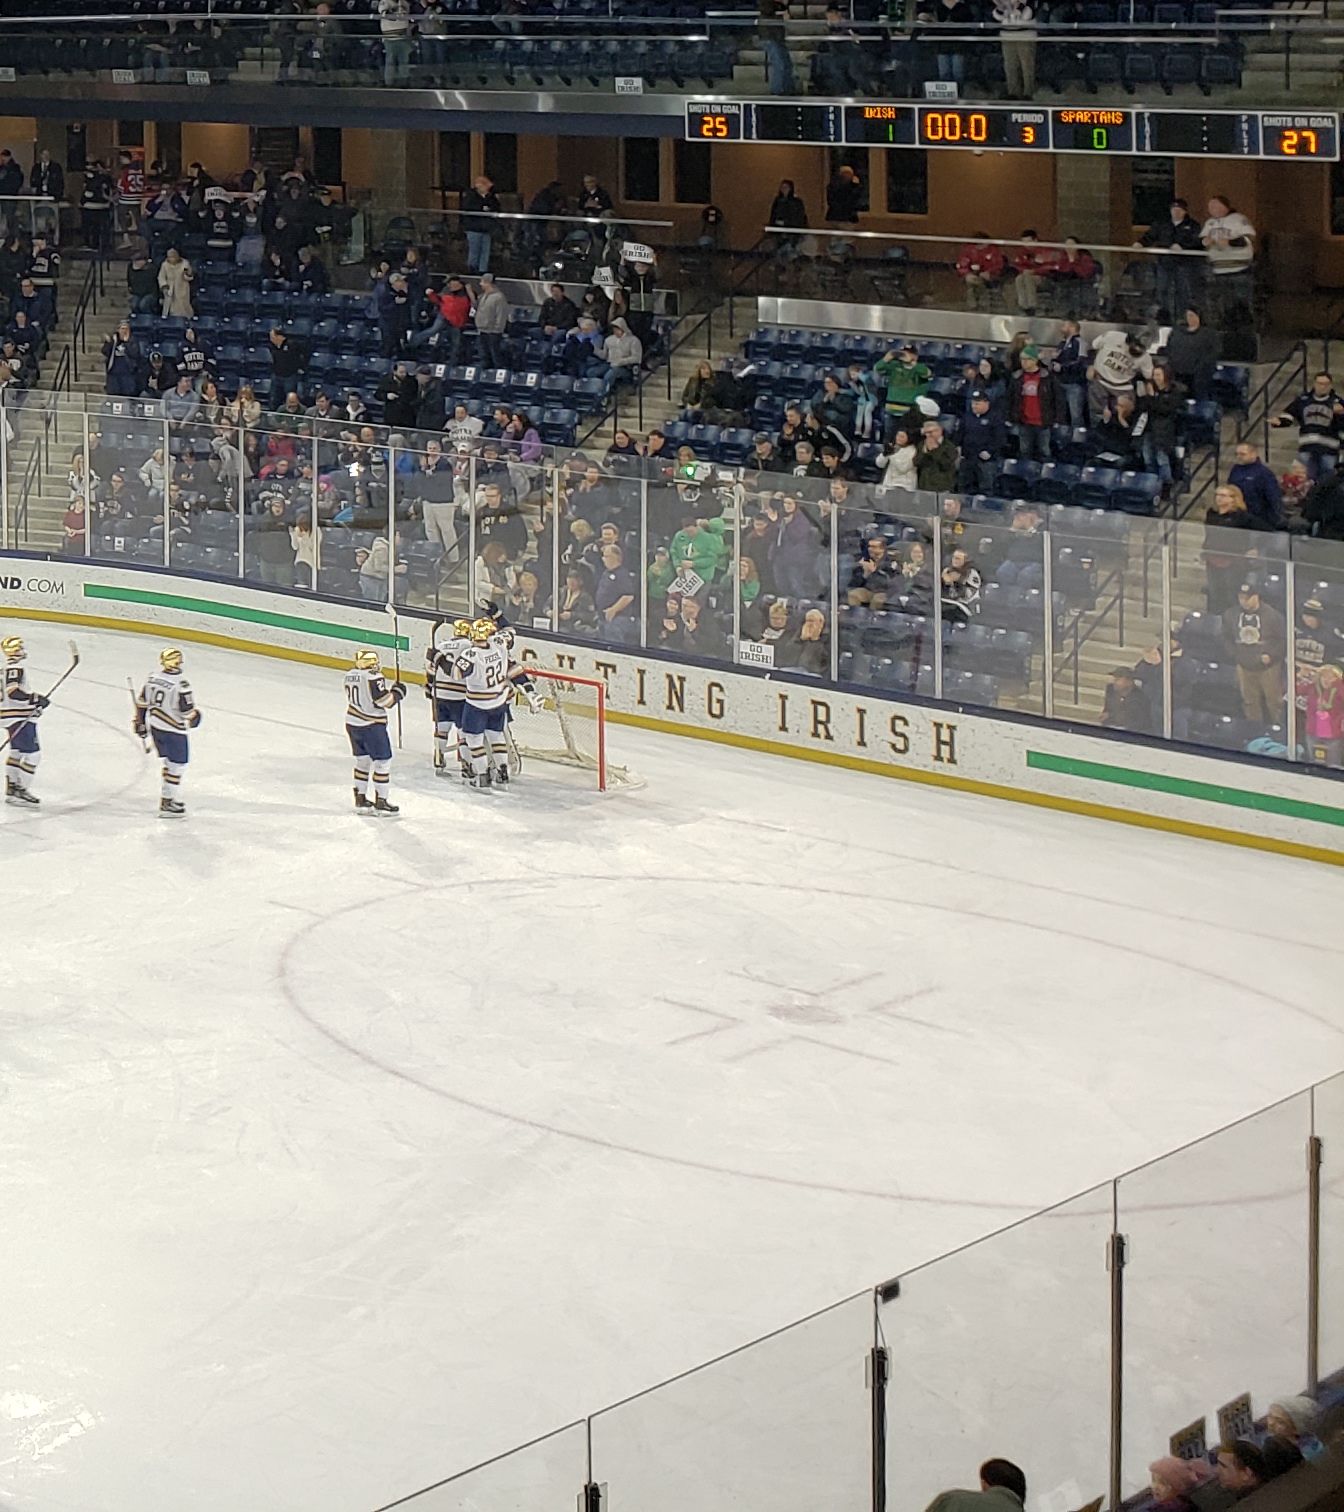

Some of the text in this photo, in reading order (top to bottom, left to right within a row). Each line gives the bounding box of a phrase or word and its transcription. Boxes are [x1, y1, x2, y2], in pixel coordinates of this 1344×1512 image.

[864, 107, 896, 119] IRISH
[1012, 113, 1044, 123] PERIOD
[1061, 111, 1123, 124] SPARTANS
[702, 116, 728, 137] 25
[926, 113, 987, 141] 00.0
[1264, 116, 1292, 127] SHOTS
[1309, 117, 1334, 128] GOAL
[1022, 126, 1034, 144] 3
[1093, 128, 1106, 149] 0
[1283, 131, 1316, 154] 27
[749, 645, 762, 654] GO
[458, 659, 470, 671] 22
[740, 651, 771, 664] IRISH!
[486, 663, 505, 688] 22
[778, 692, 957, 764] IRISH
